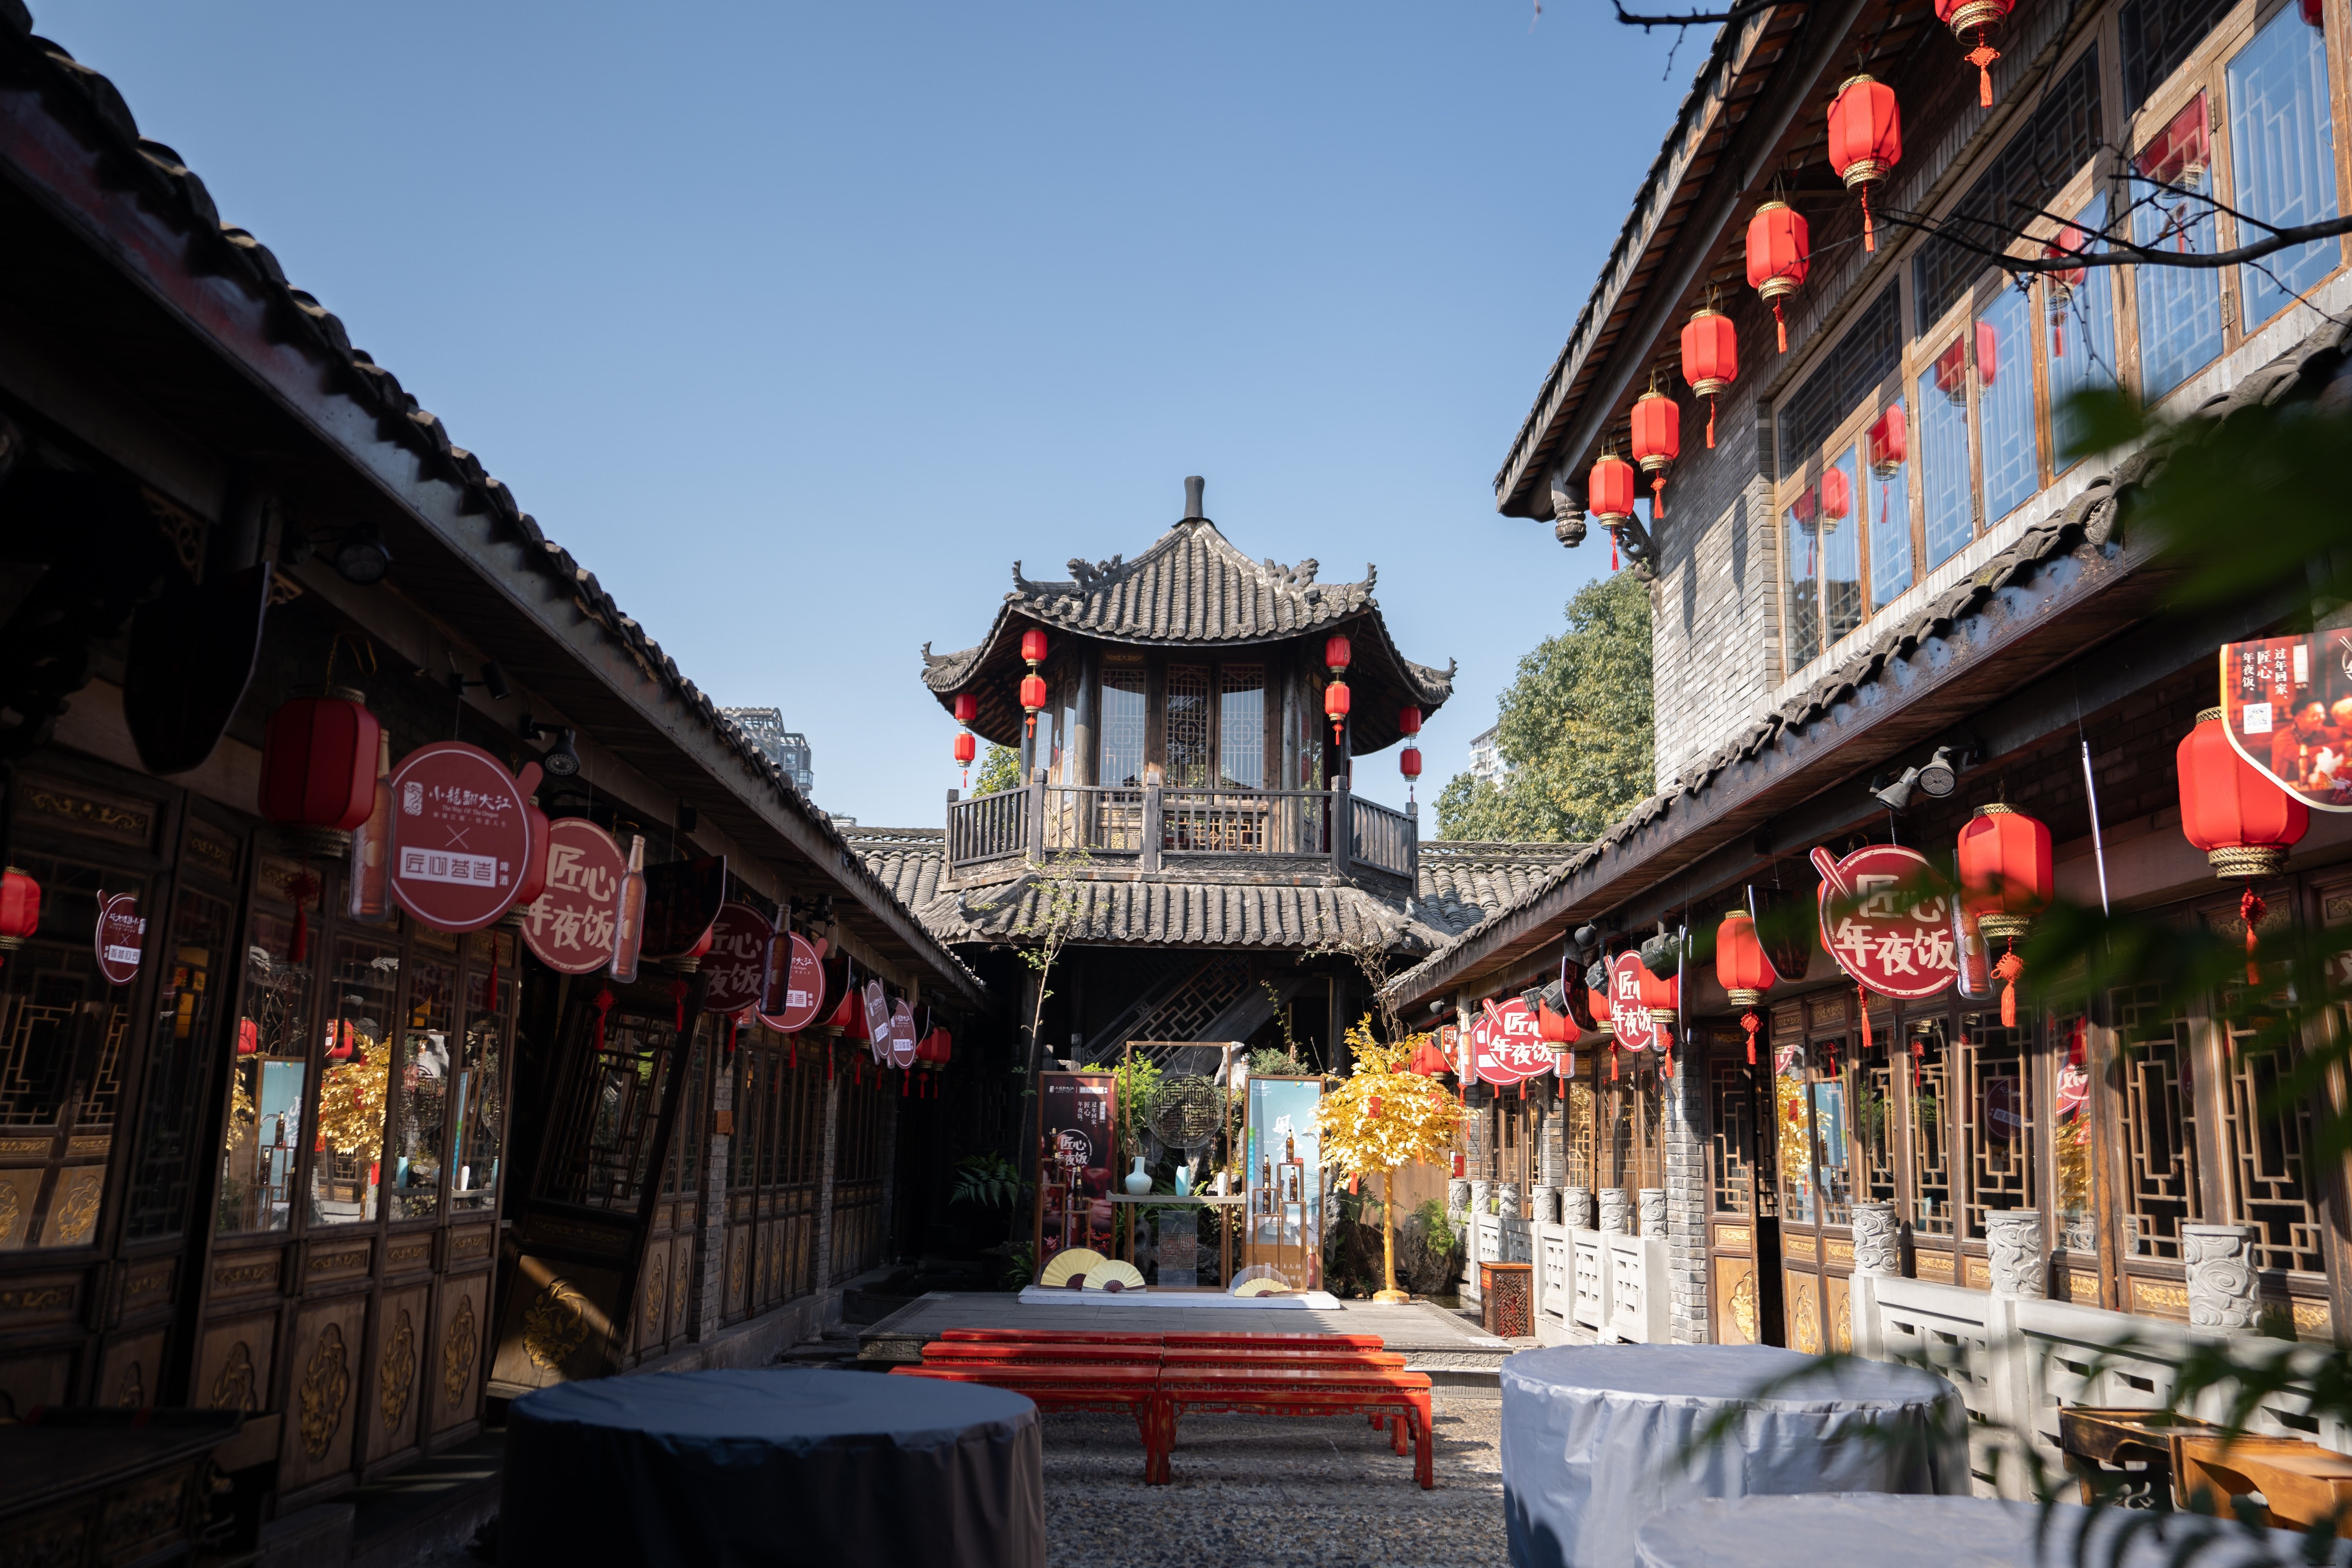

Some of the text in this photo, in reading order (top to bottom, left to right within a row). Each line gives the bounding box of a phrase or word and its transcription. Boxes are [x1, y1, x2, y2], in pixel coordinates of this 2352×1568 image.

[2256, 650, 2272, 679] 匠心
[452, 806, 462, 814] Way
[482, 810, 498, 818] Dragon
[499, 862, 509, 886] 啤酒
[546, 843, 616, 902] 匠心
[1856, 875, 1945, 922] 匠心
[528, 894, 614, 952] 年夜饭
[1834, 918, 1958, 976] 年夜饭
[1611, 1000, 1653, 1037] 年夜饭
[1489, 1035, 1555, 1065] 年夜饭
[1084, 1102, 1091, 1116] 匠心
[1060, 1137, 1087, 1151] 匠心
